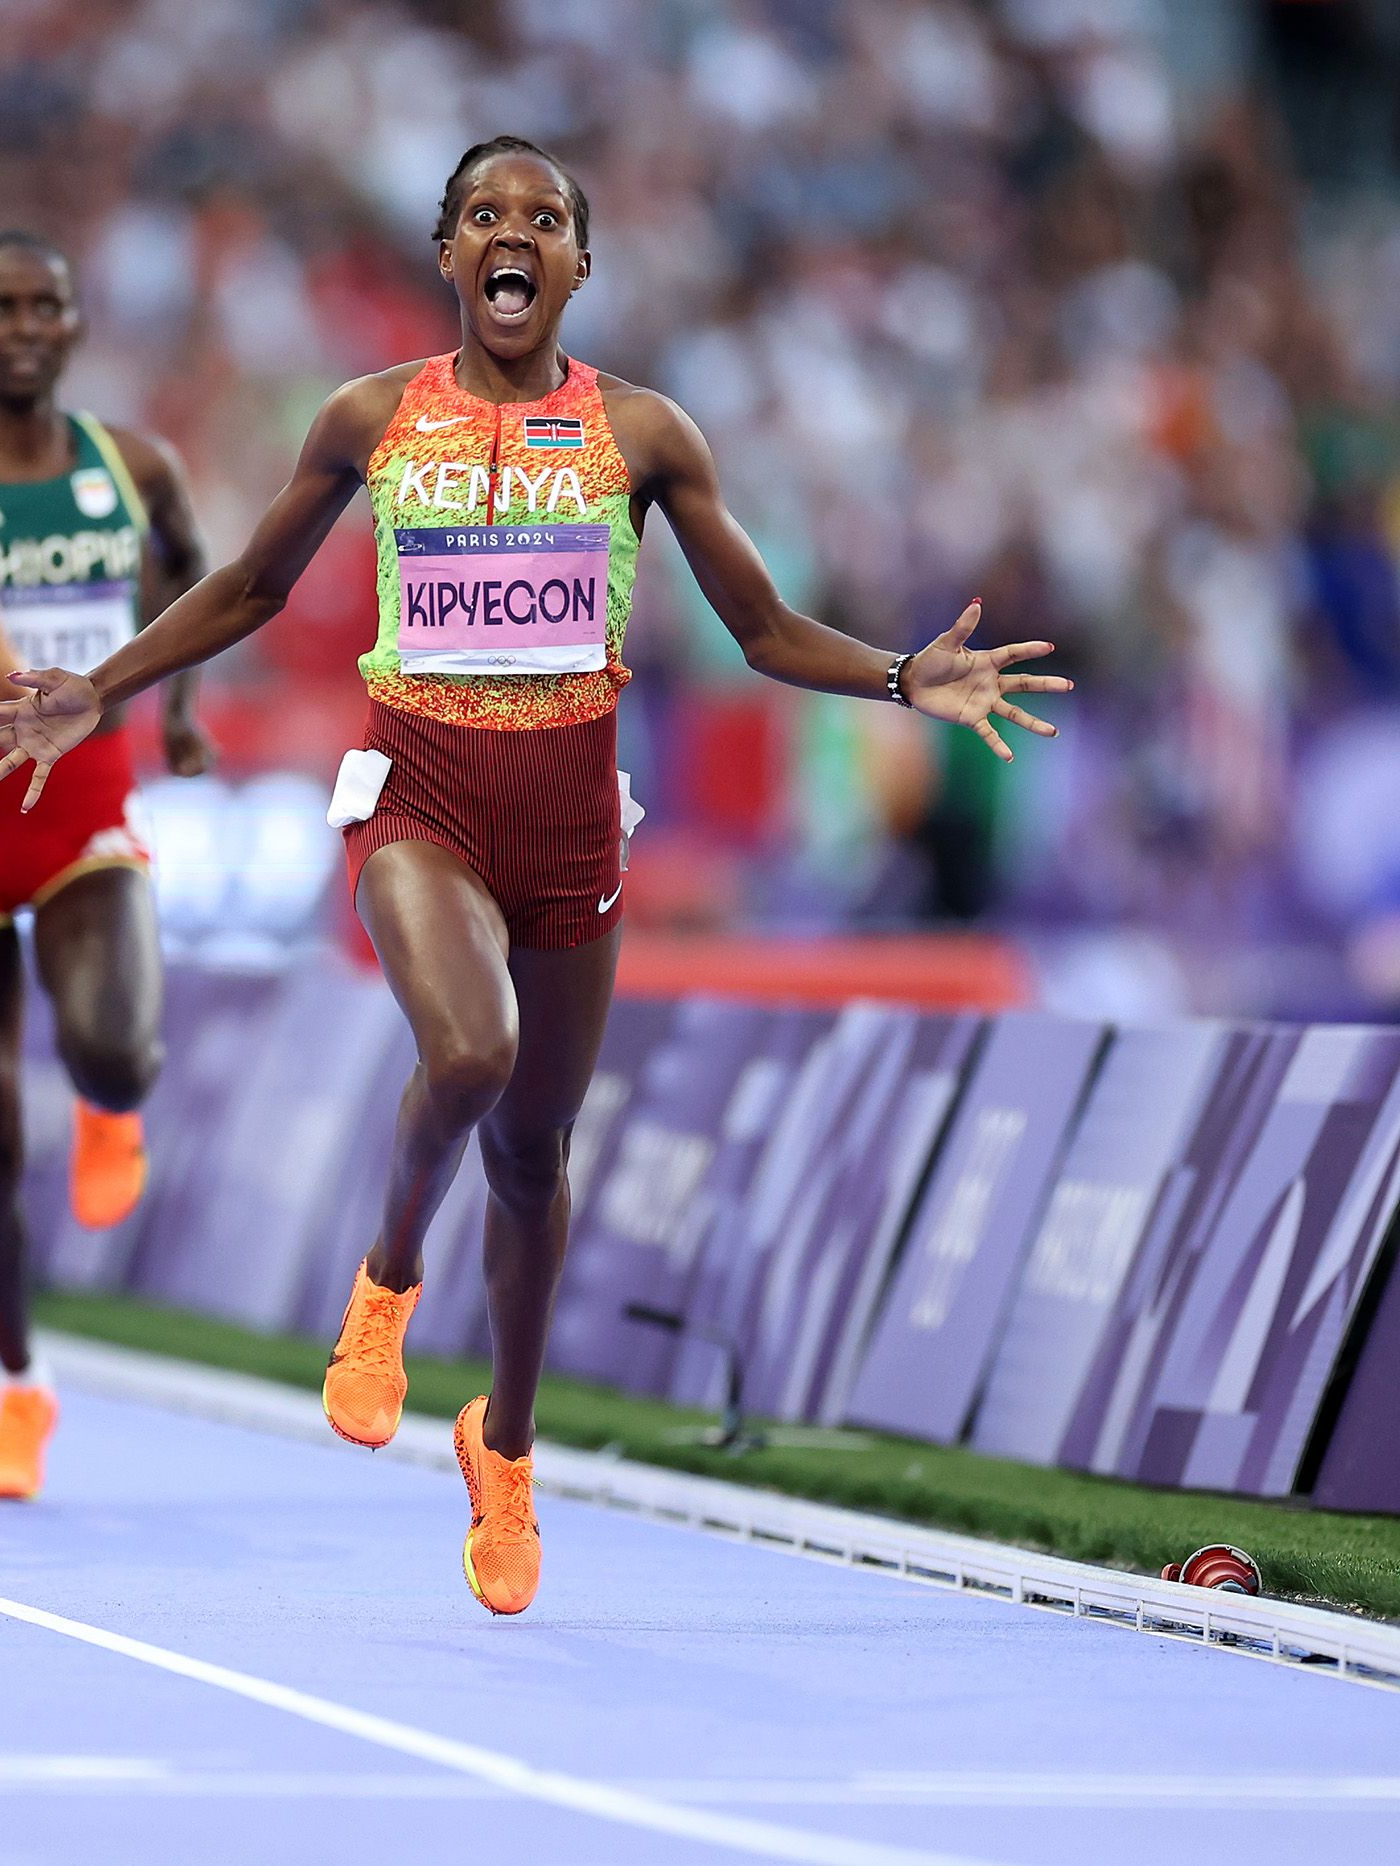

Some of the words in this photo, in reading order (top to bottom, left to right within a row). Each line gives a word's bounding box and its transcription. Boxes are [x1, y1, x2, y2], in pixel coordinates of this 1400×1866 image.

[397, 460, 588, 515] KENYA
[446, 534, 499, 548] PARIS
[505, 532, 555, 547] 2024
[406, 576, 596, 628] KIPYEGON
